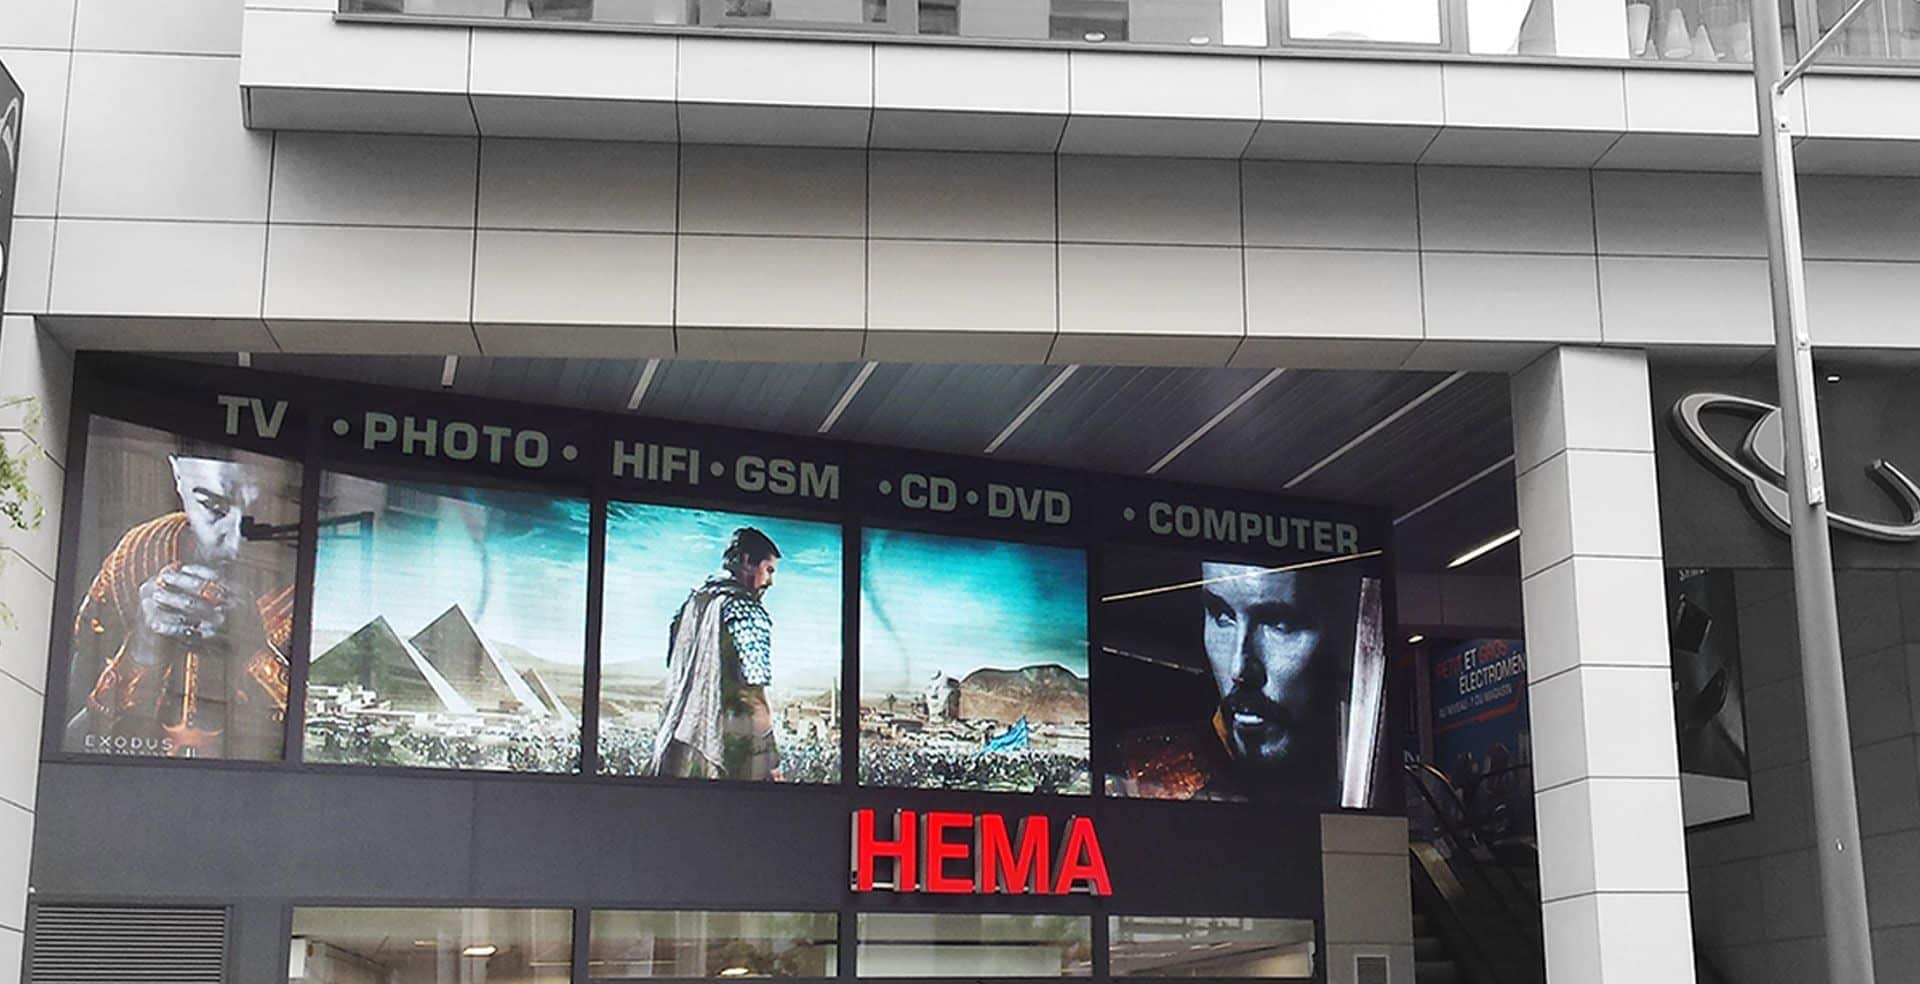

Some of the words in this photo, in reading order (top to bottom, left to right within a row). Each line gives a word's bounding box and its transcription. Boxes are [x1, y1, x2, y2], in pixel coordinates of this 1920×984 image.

[217, 394, 288, 438] TV
[363, 411, 549, 468] PHOTO
[612, 440, 699, 485] HIFI
[735, 455, 839, 499] GSM
[901, 473, 957, 511] CD
[988, 483, 1071, 524] DVD
[1149, 501, 1359, 553] COMPUTER
[1464, 647, 1477, 670] ET
[84, 734, 174, 751] EXODUS
[852, 808, 1112, 896] HEMA
